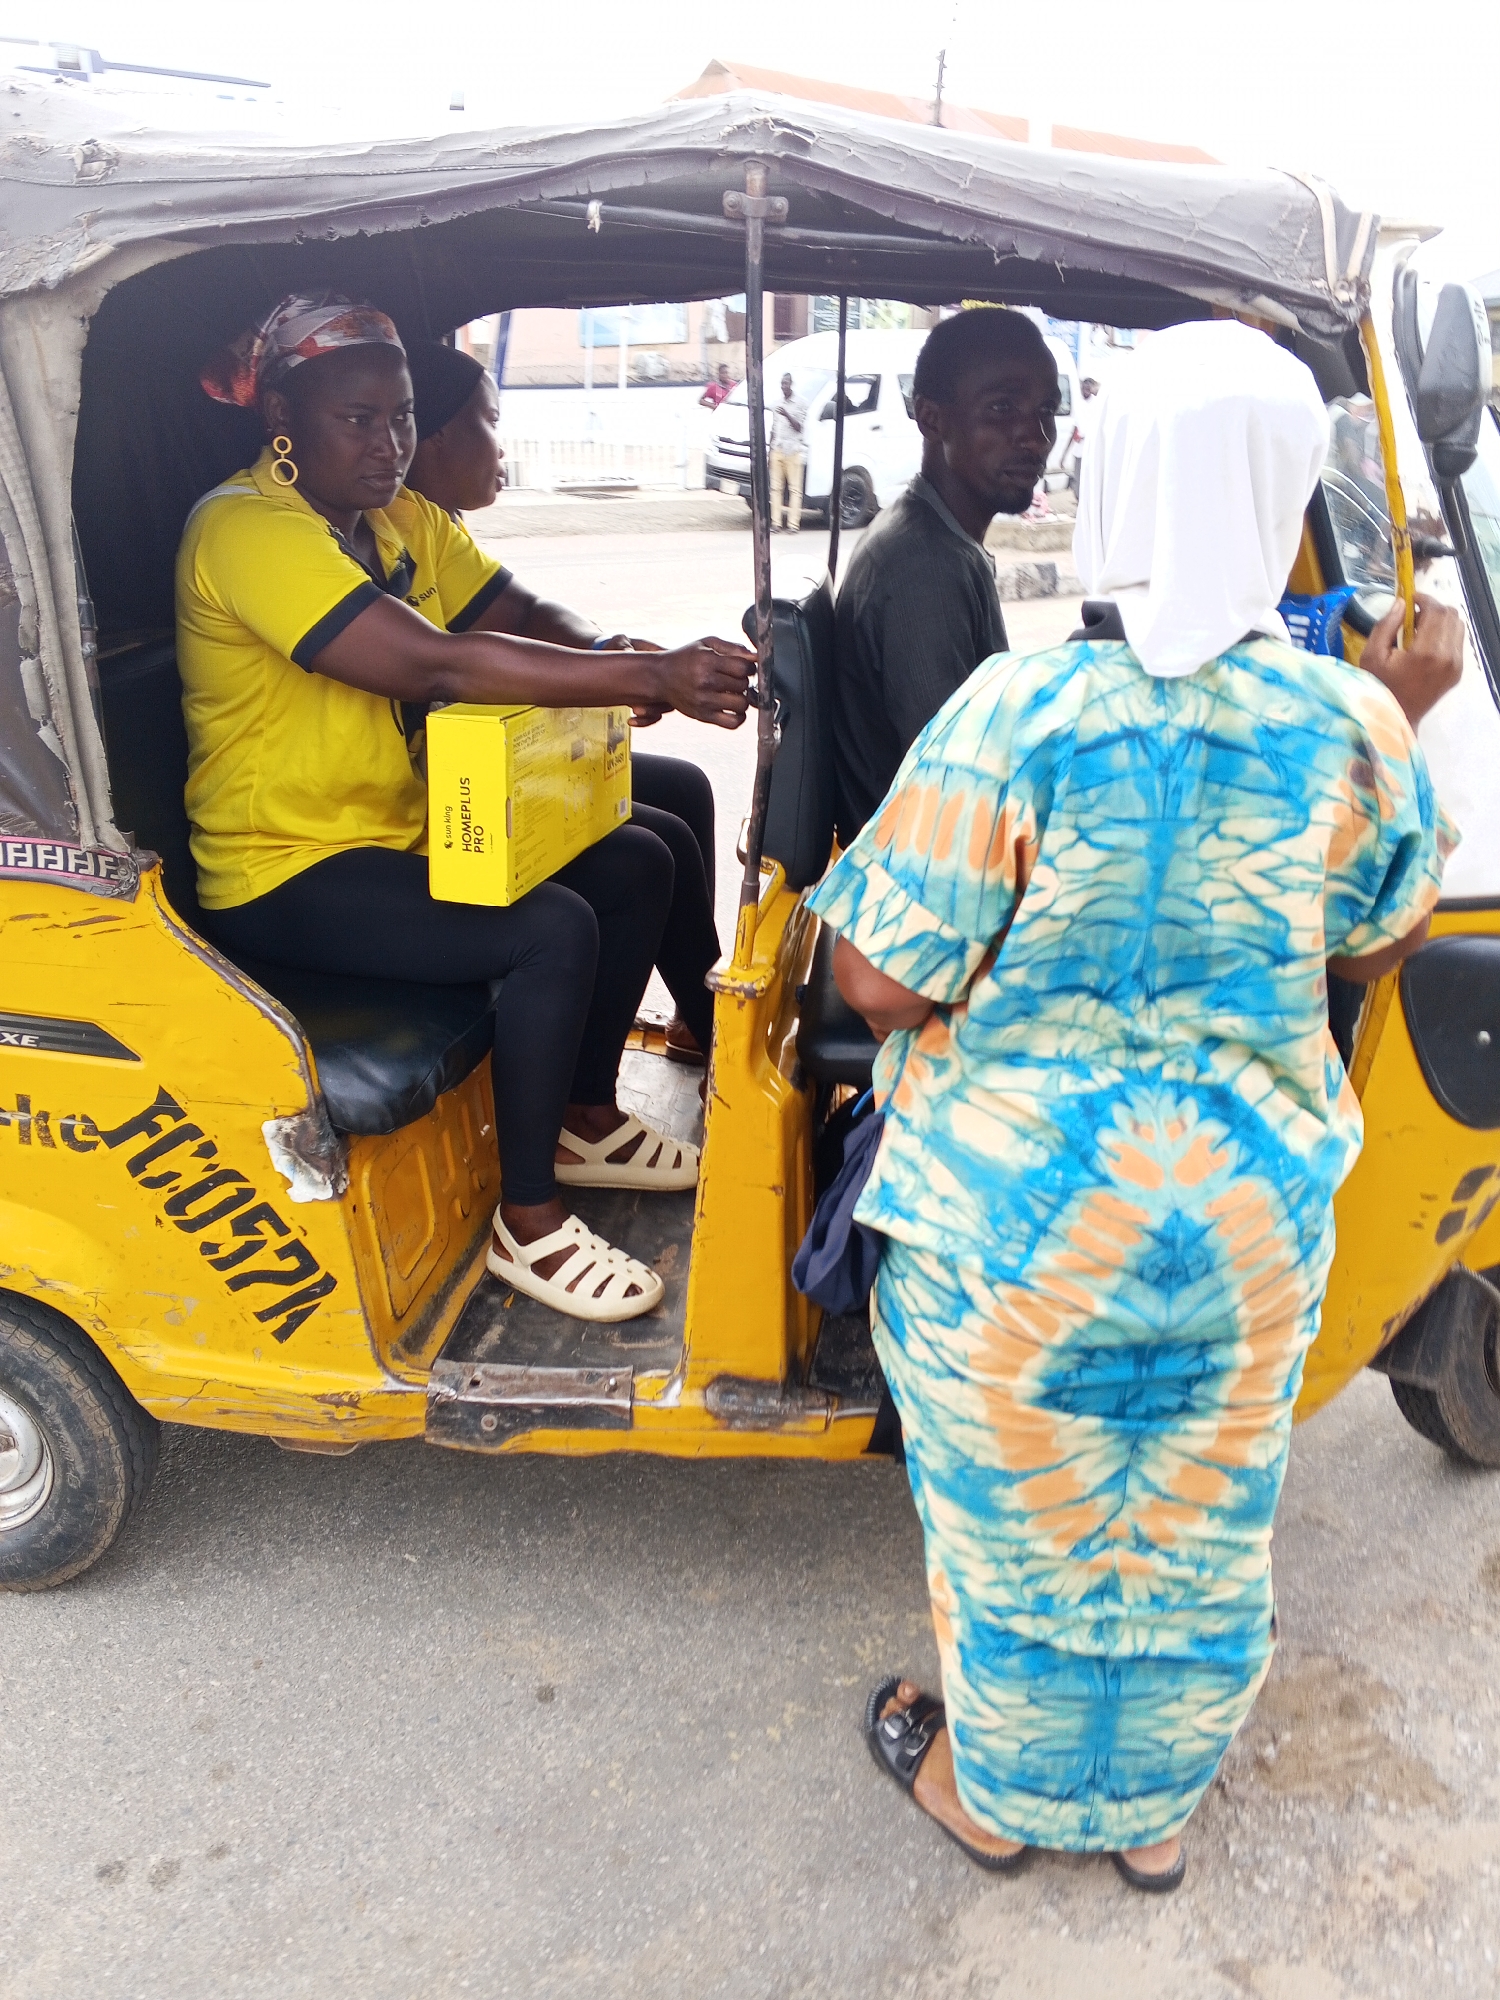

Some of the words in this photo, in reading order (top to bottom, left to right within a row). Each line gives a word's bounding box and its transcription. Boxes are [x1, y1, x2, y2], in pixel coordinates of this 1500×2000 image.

[419, 587, 437, 602] sun
[444, 806, 453, 823] king
[460, 777, 472, 852] HOMEPLUS
[473, 825, 484, 854] PRO
